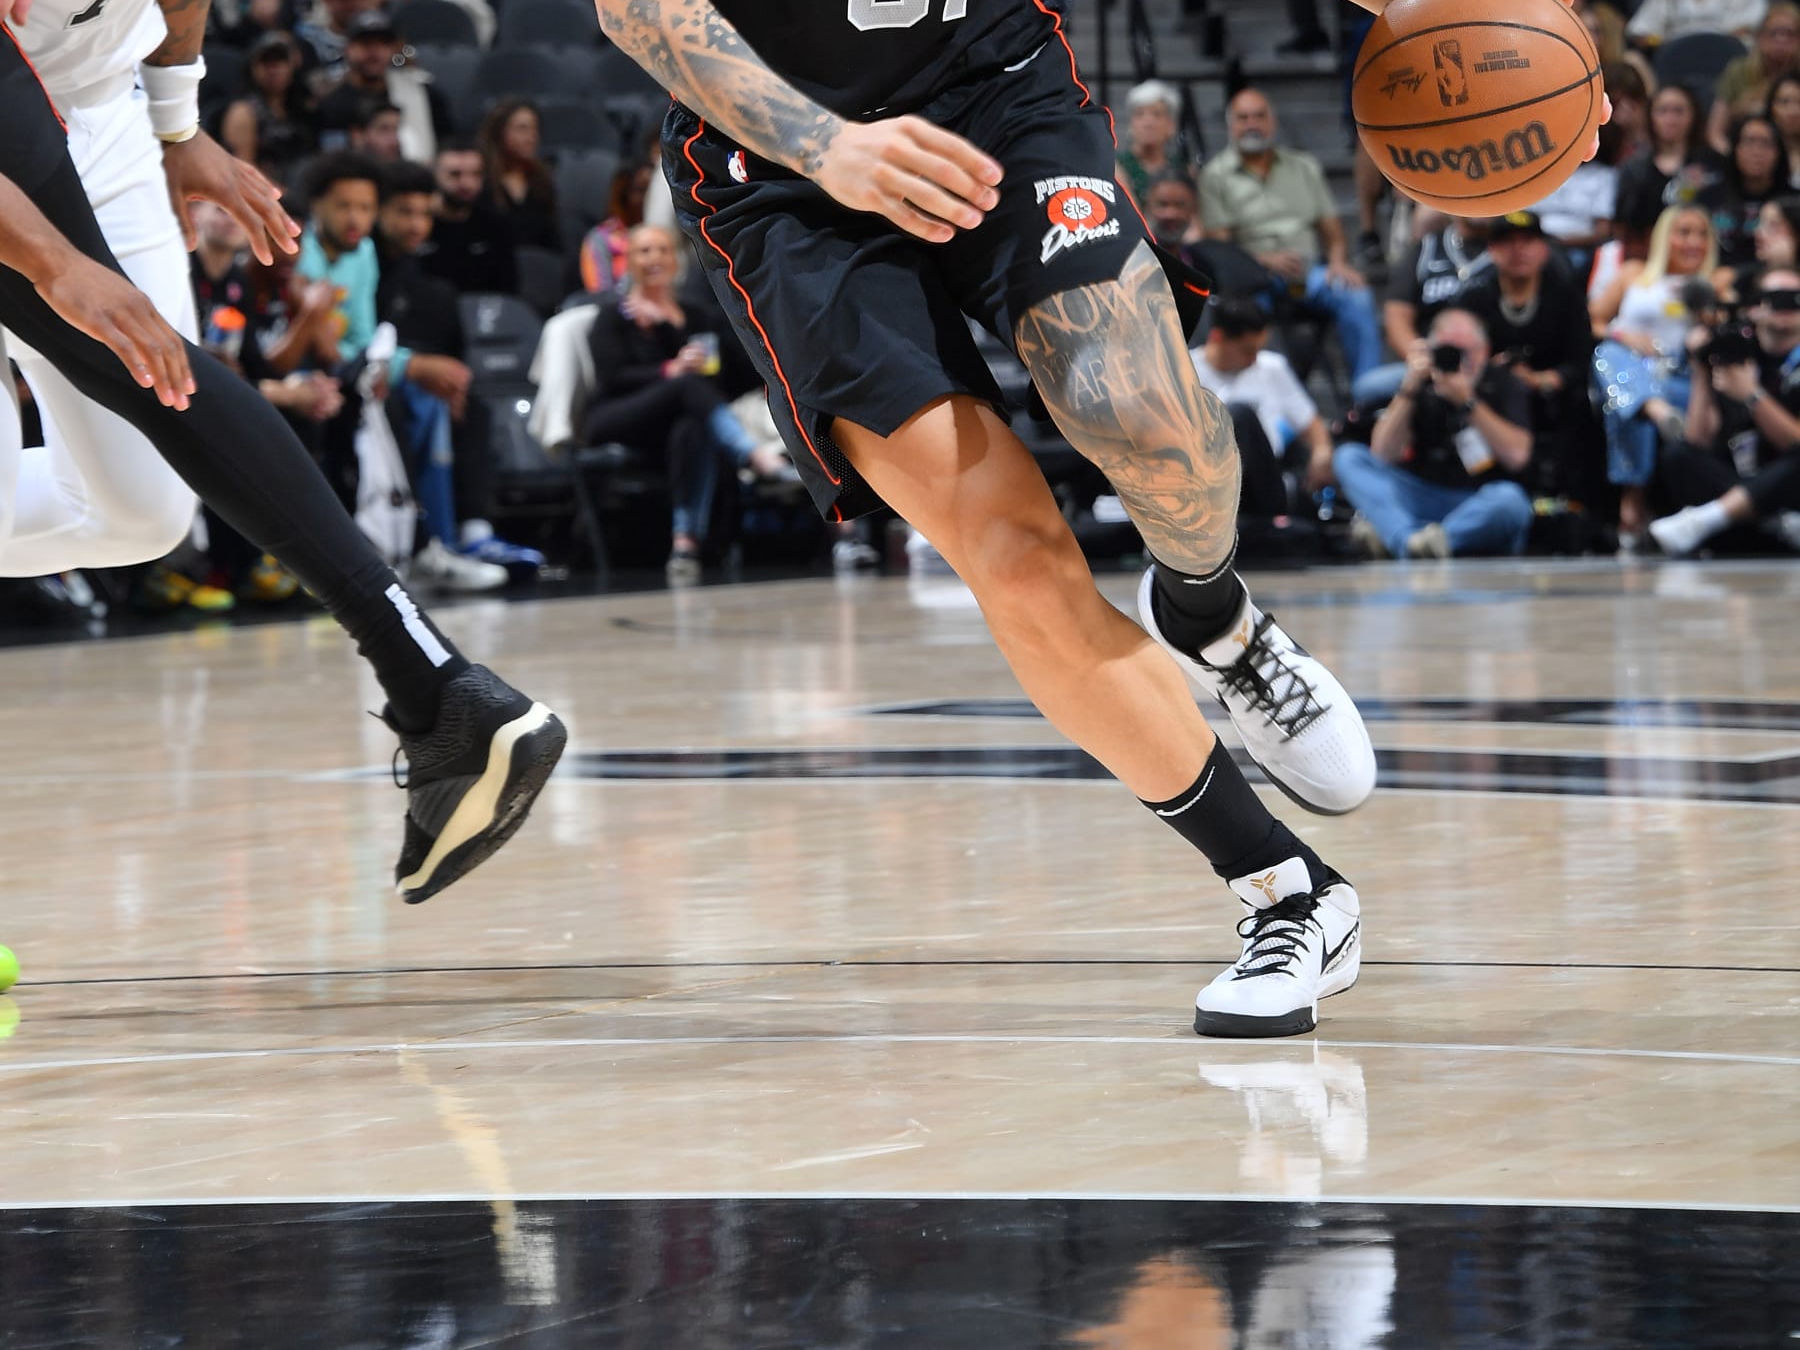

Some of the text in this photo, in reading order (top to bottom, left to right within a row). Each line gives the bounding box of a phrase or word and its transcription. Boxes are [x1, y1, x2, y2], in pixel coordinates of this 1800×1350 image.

[1386, 120, 1557, 180] Wilson
[1033, 175, 1116, 205] PISTONS
[1040, 217, 1120, 265] Detroit
